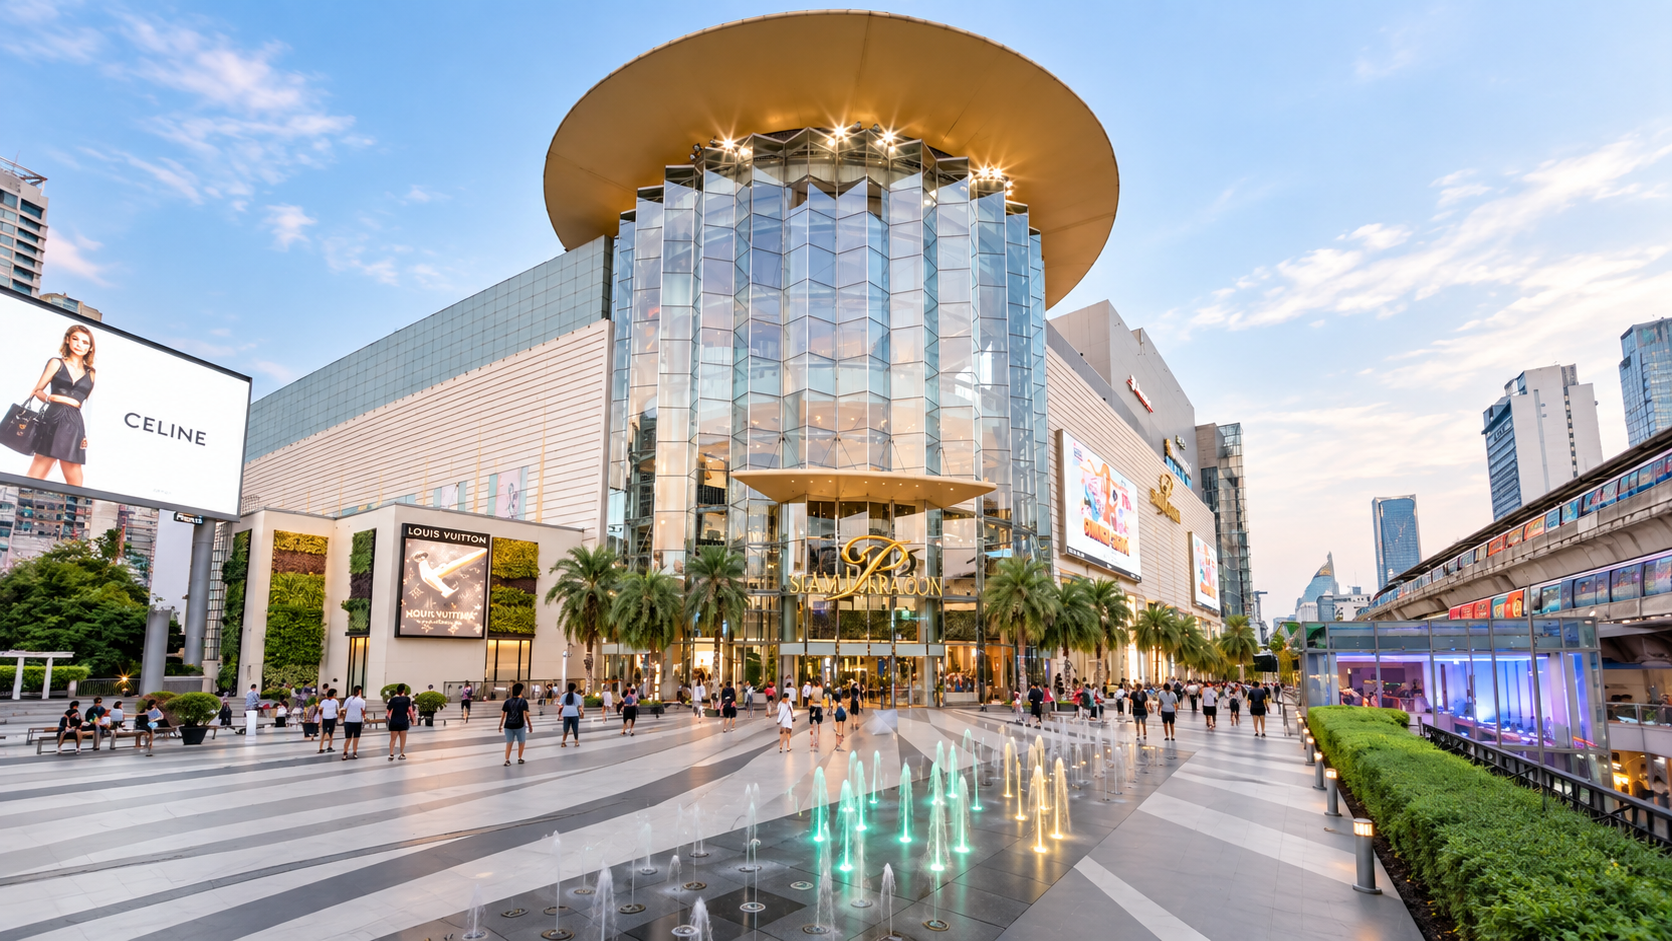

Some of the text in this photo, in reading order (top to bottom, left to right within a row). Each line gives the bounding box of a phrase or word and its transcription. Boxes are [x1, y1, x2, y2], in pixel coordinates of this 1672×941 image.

[124, 412, 207, 447] CELINE
[408, 526, 487, 544] LOUIS VUITTON
[789, 571, 841, 594] SIAM
